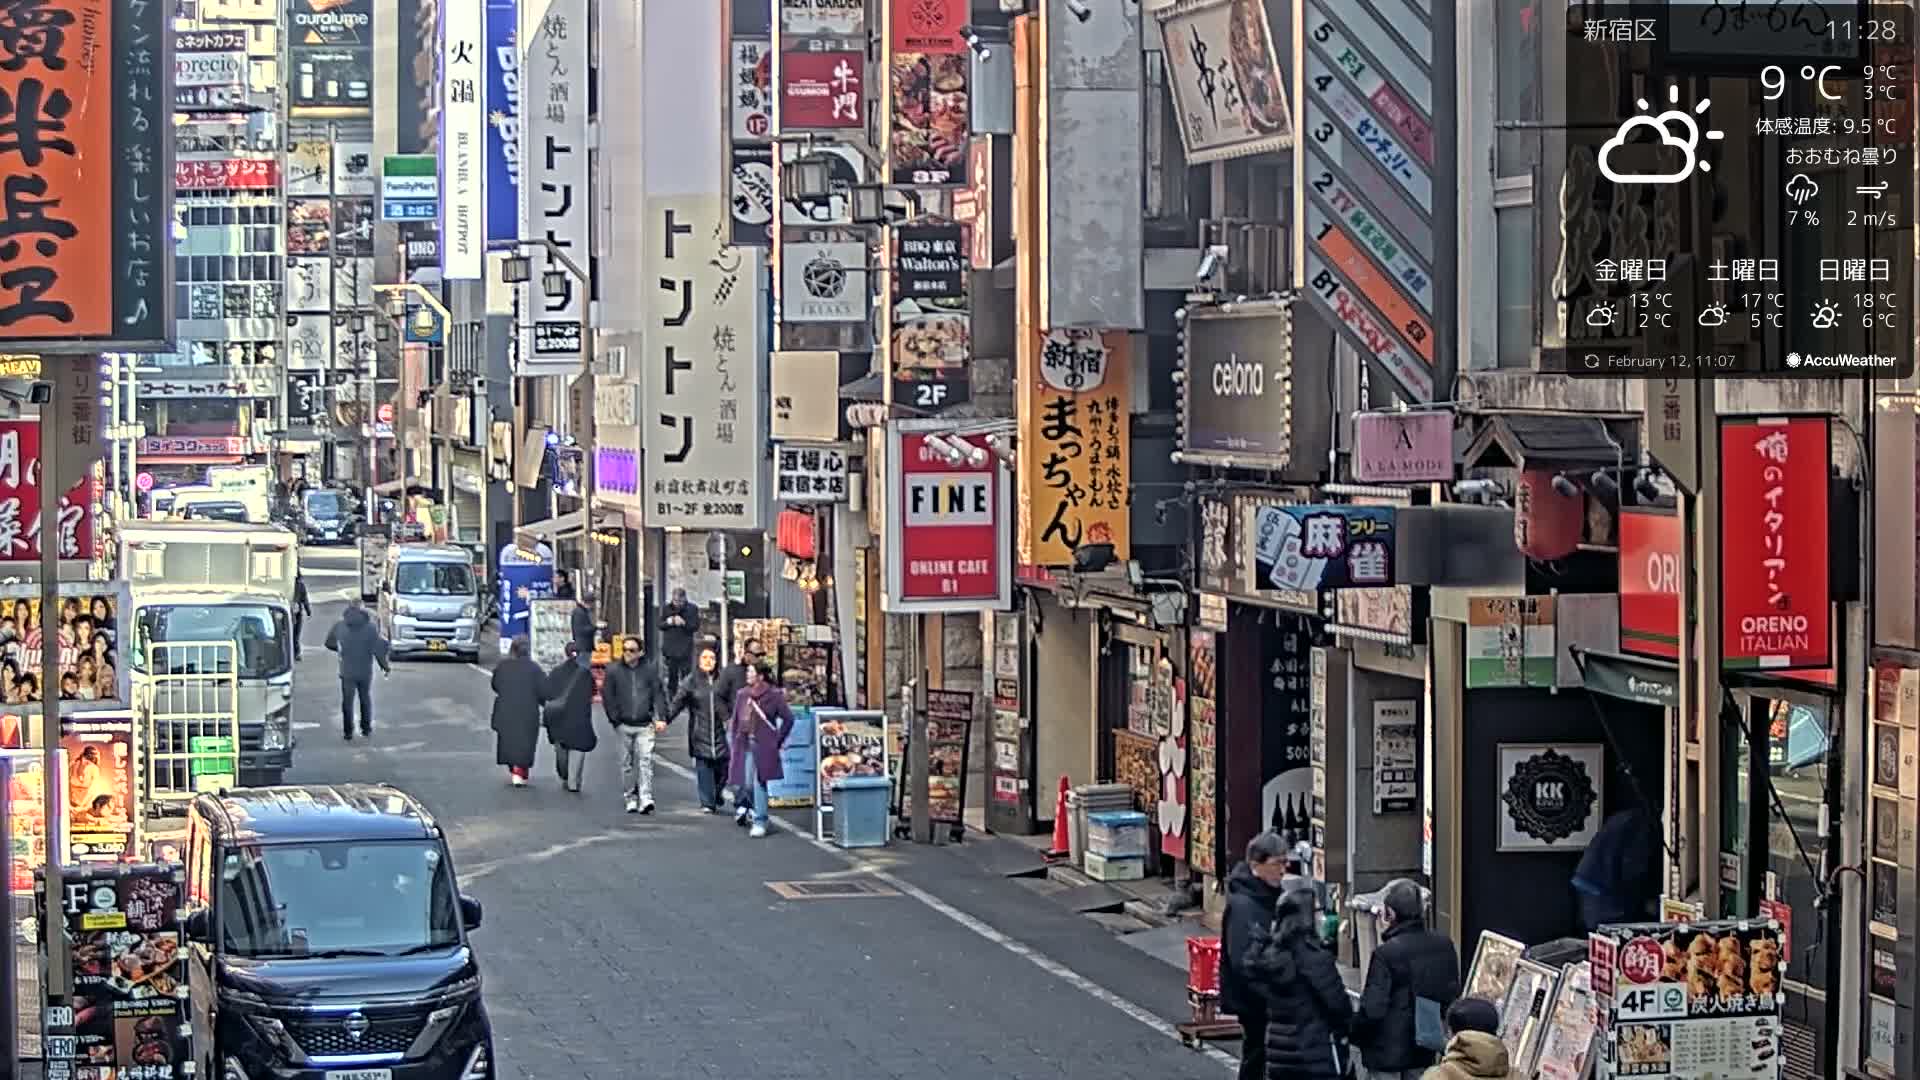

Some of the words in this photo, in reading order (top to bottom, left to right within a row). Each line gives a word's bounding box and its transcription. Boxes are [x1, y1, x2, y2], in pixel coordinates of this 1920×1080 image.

[296, 12, 368, 25] auralume
[1314, 22, 1334, 42] 5
[451, 41, 474, 103] 火鍋
[830, 59, 859, 120] 牛門
[1314, 74, 1334, 92] 4
[1314, 122, 1334, 142] 3
[1357, 119, 1412, 179] センチュリー
[386, 182, 436, 192] FamilyMart
[1313, 172, 1333, 193] 2
[458, 205, 468, 254] HOTPOT
[1317, 223, 1332, 240] 1
[902, 257, 960, 272] Walton's
[1312, 269, 1340, 299] B1
[660, 210, 693, 464] トントン
[1045, 341, 1103, 374] 新宿
[1065, 374, 1083, 388] の
[1212, 353, 1263, 395] celona
[713, 325, 737, 444] 焼とん酒場
[916, 385, 947, 405] 2F
[1041, 396, 1085, 548] まっちゃん
[1403, 460, 1444, 472] MODE
[780, 475, 843, 493] 新宿本店
[912, 485, 987, 513] FINE
[1350, 517, 1390, 534] フリー
[1755, 431, 1788, 604] 俺のイタリアン
[910, 560, 954, 574] ONLINE
[958, 560, 989, 574] CAFE
[1741, 615, 1808, 634] ORENO
[1740, 634, 1809, 652] ITALIAN
[822, 735, 881, 748] GYUMON
[1536, 782, 1564, 799] KK
[1621, 991, 1656, 1013] 4F
[1691, 993, 1776, 1014] 炭火焼き鳥
